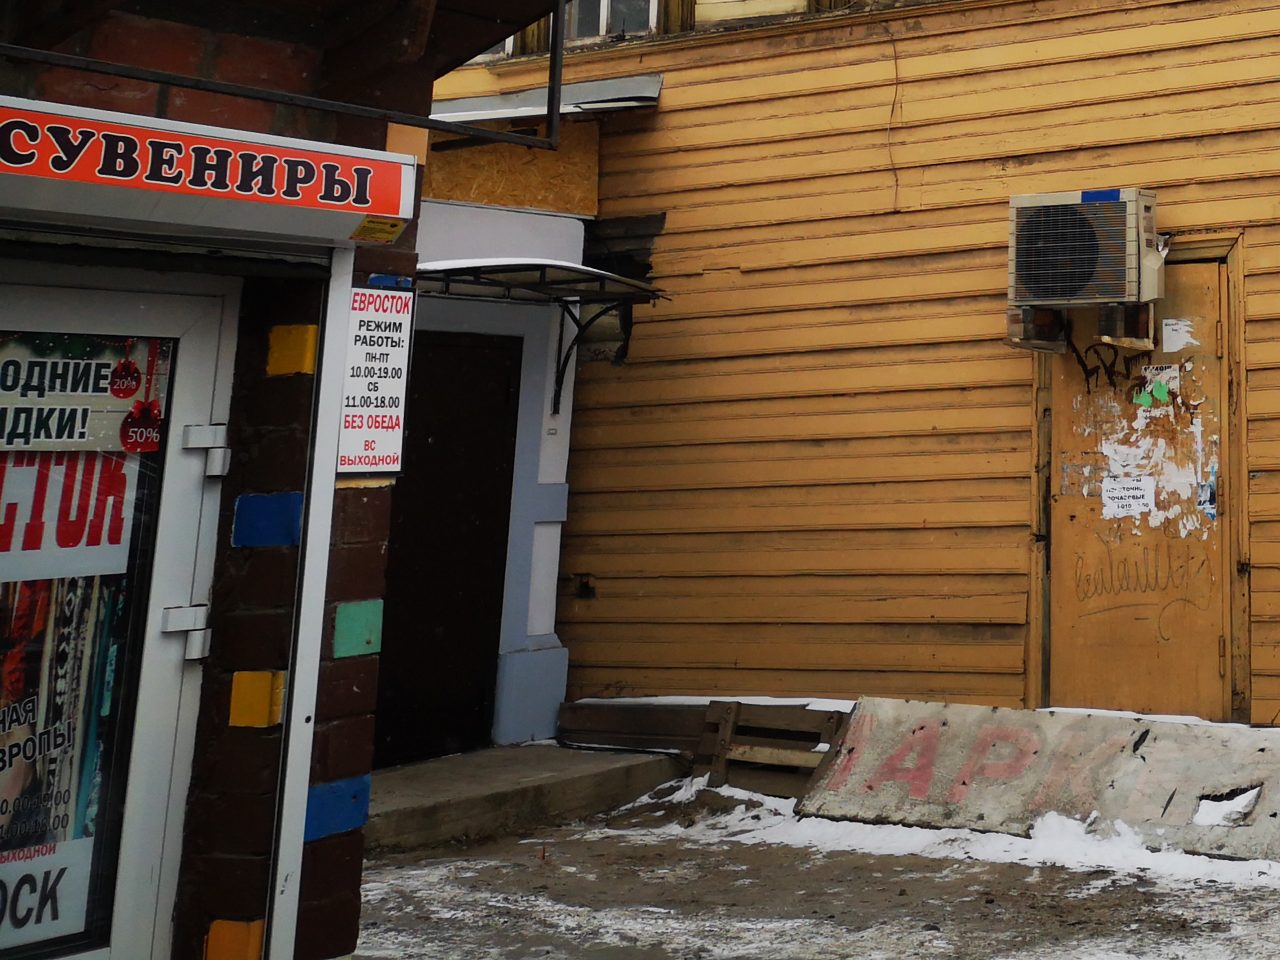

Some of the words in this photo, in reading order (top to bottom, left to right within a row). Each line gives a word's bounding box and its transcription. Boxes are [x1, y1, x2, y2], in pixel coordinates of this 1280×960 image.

[0, 118, 374, 207] СУВЕНИРЫ
[352, 292, 411, 314] ЕВРОСТОК
[358, 319, 402, 333] РЕЖИМ
[354, 335, 404, 348] РАБОТЫ:
[365, 352, 390, 363] ПН-ПТ
[350, 367, 402, 379] 10.00-19.00
[367, 382, 379, 392] СБ
[344, 396, 400, 408] 11.00-18.00
[344, 415, 364, 429] БЕЗ
[367, 415, 400, 432] ОБЕДА
[127, 427, 160, 443] 50%
[364, 440, 376, 451] ВС
[339, 453, 399, 467] ВЫХОДНОЙ
